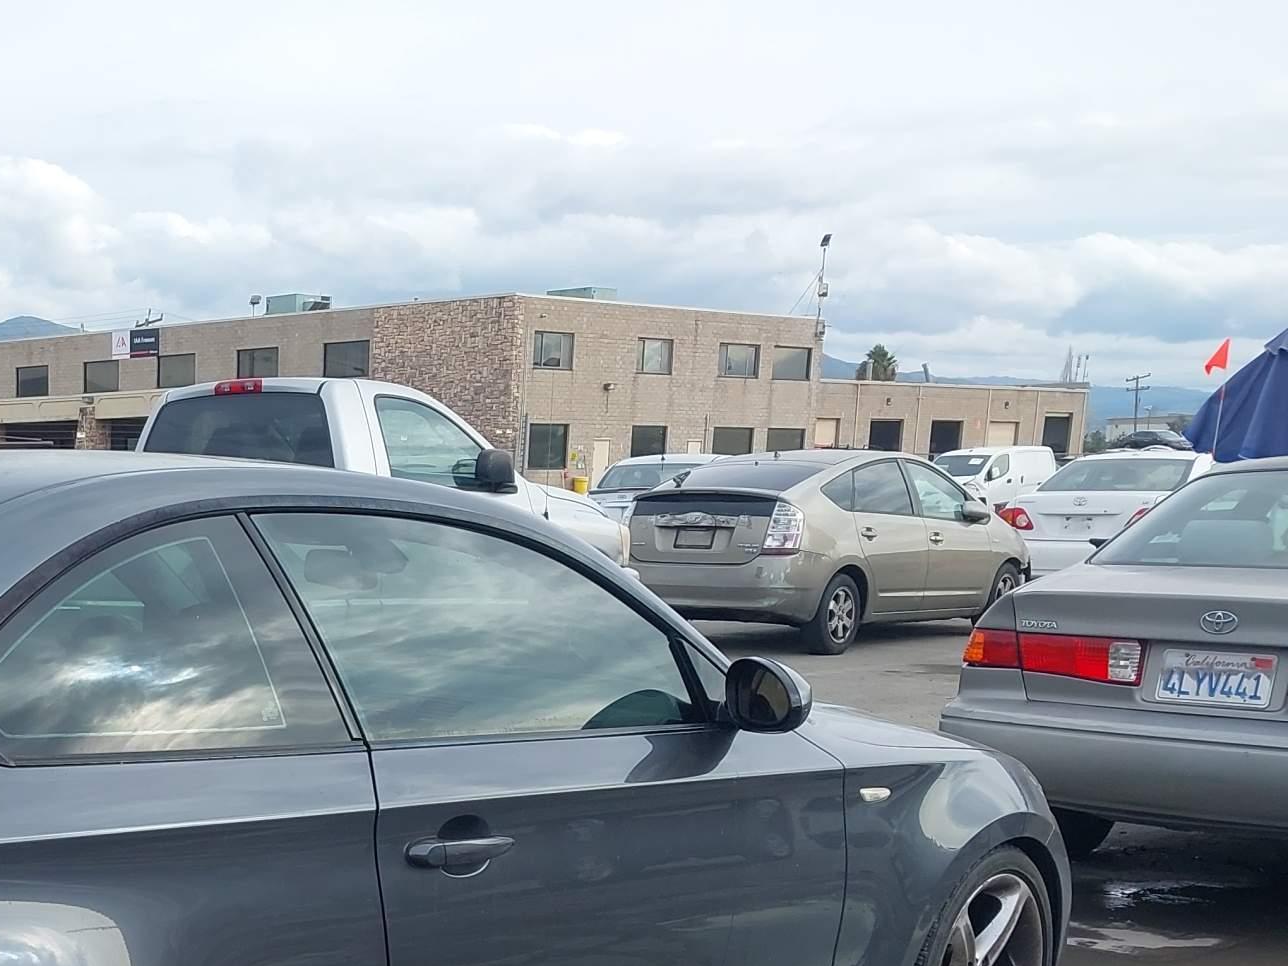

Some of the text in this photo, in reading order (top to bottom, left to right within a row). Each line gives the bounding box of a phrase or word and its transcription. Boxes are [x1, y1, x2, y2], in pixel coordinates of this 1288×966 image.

[1021, 619, 1058, 629] TOYOTA
[1184, 654, 1250, 669] California
[1161, 670, 1263, 700] 4LYV441
